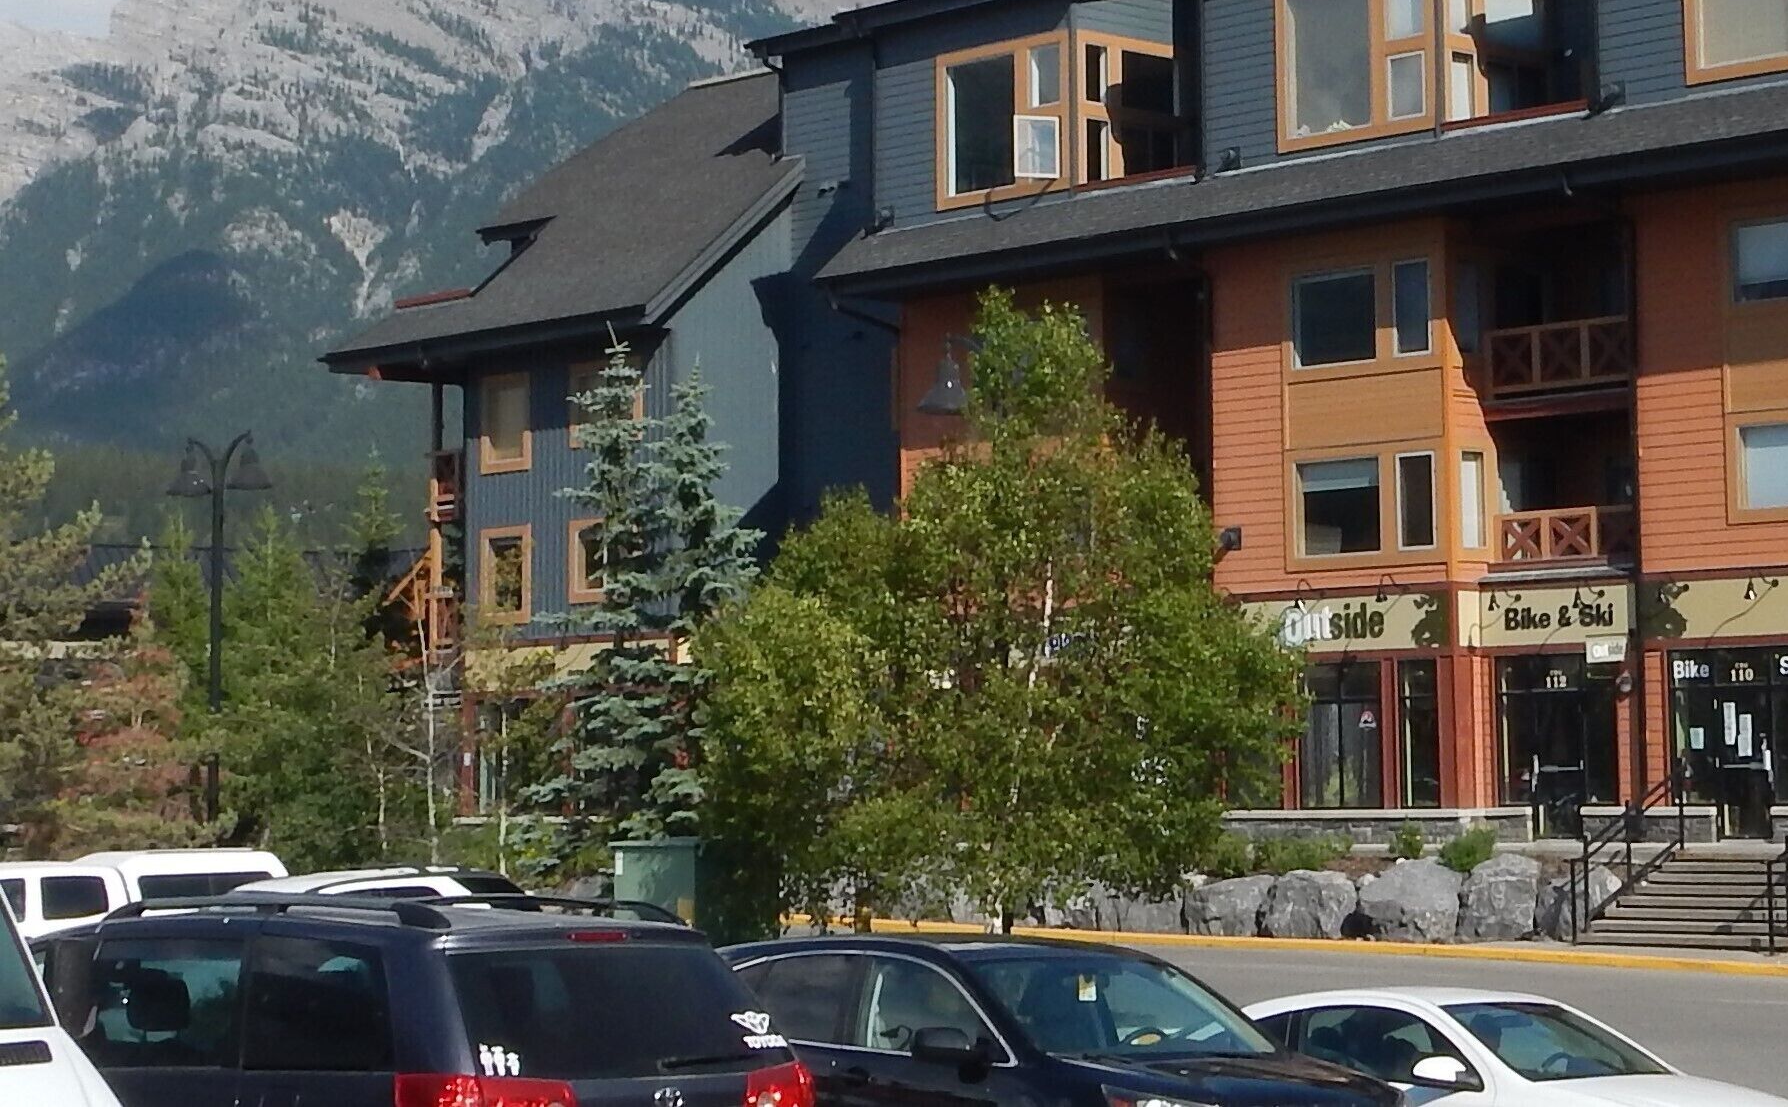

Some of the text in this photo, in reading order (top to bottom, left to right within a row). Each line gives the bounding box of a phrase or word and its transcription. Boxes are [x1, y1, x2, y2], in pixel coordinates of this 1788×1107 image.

[1282, 602, 1385, 648] Outside
[1504, 602, 1614, 631] Bike & Ski
[1672, 659, 1711, 680] Bike
[1730, 668, 1755, 682] 110
